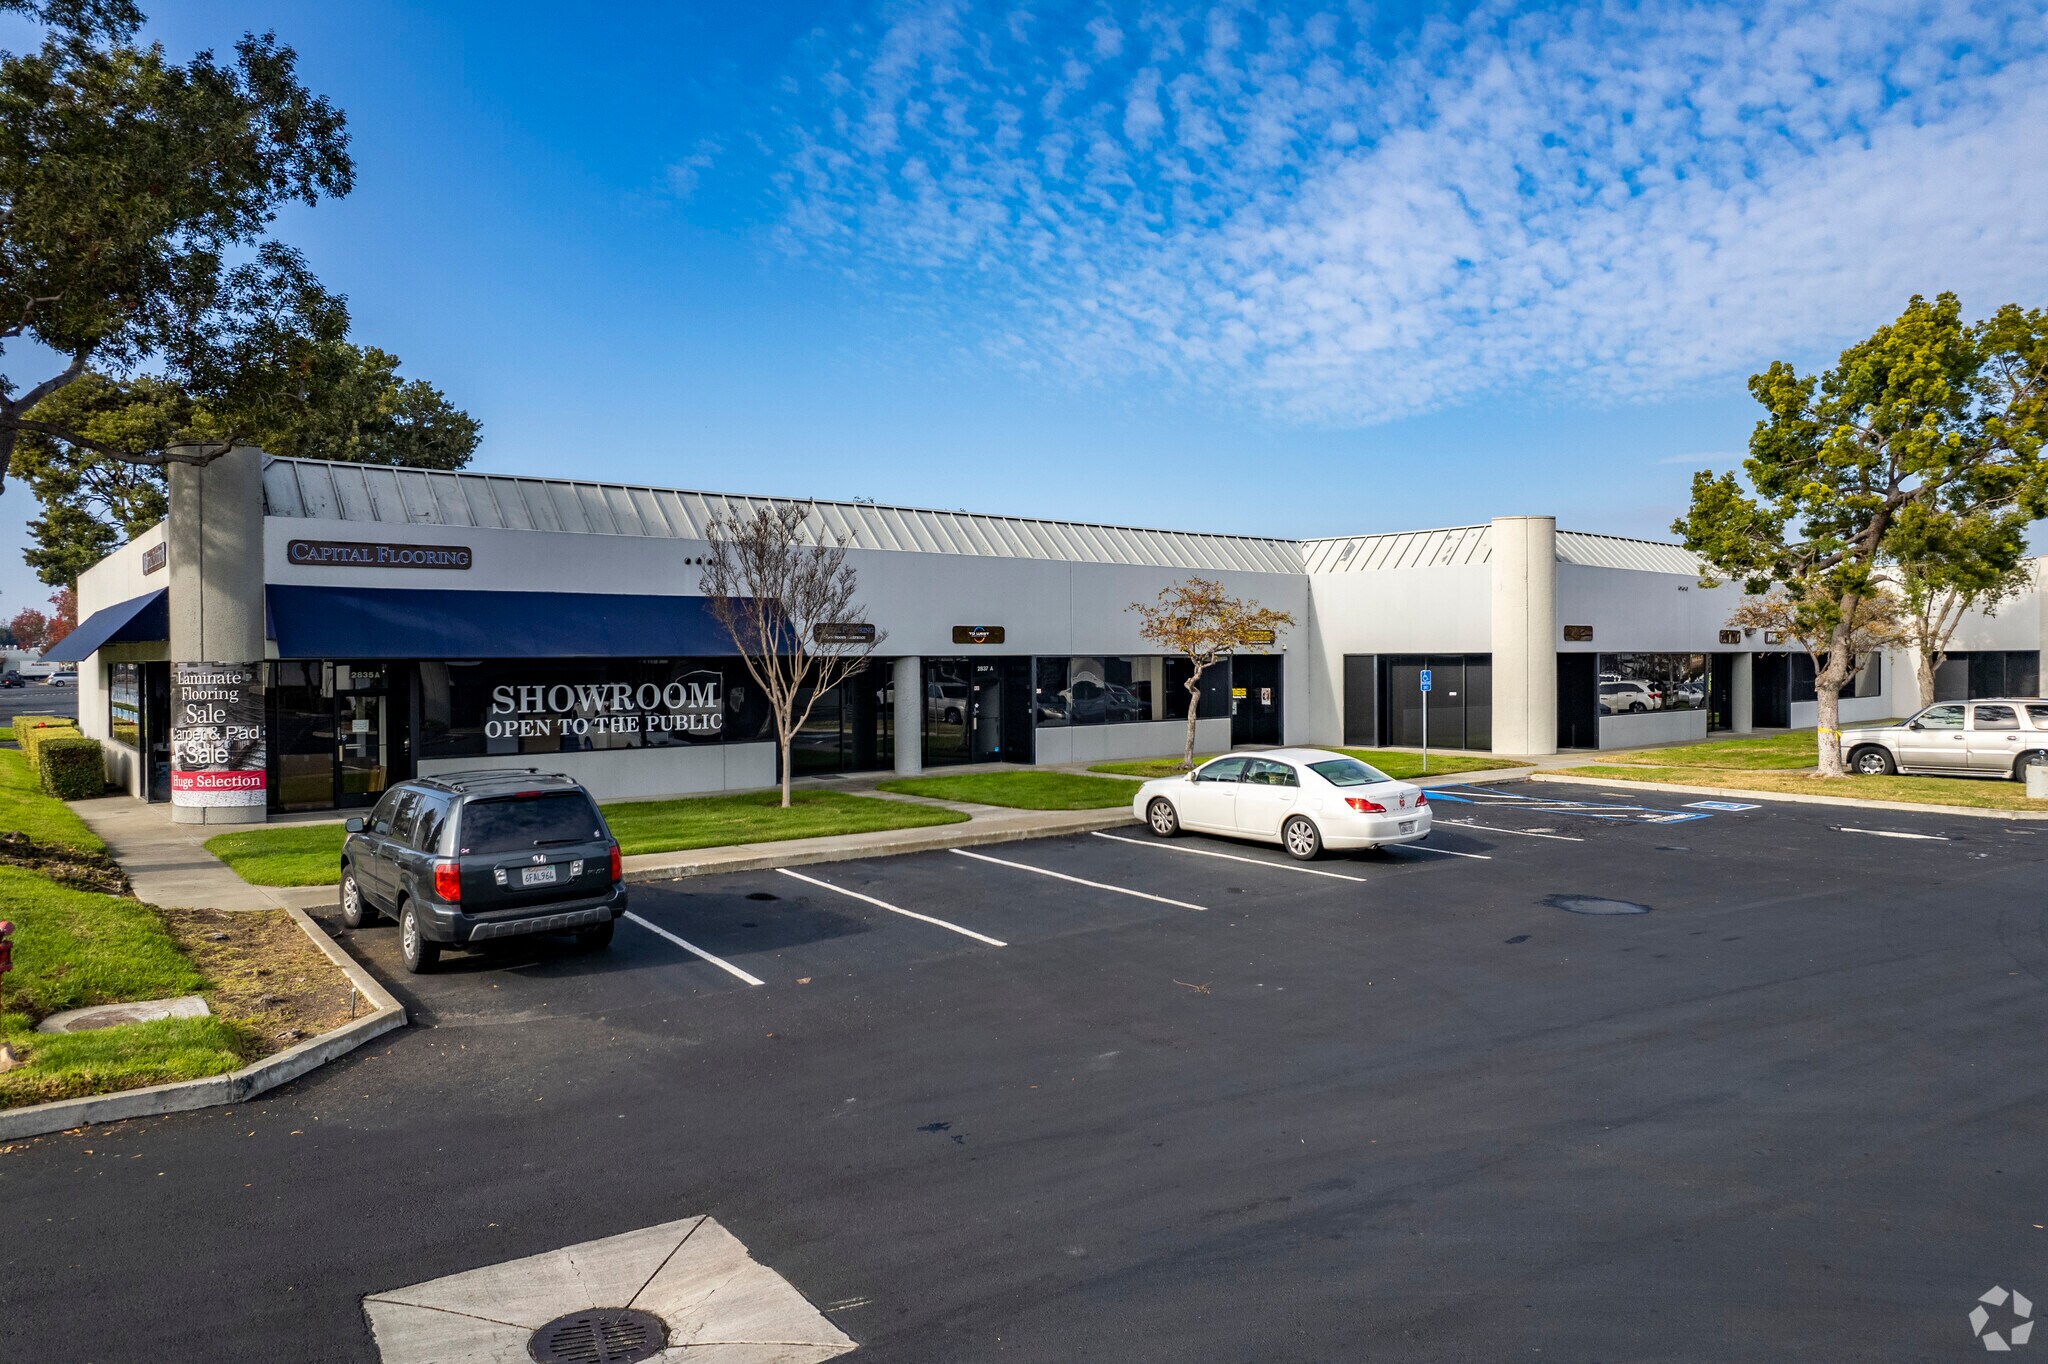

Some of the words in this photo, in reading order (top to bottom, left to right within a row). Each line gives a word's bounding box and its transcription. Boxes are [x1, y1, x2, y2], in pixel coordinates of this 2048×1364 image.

[177, 671, 241, 685] Laminate
[182, 686, 239, 703] Flooring
[492, 682, 718, 715] SHOWROOM
[186, 703, 226, 724] Sale
[171, 727, 206, 741] Carpet
[209, 726, 221, 740] &
[226, 725, 260, 740] Pad
[484, 718, 552, 739] OPEN
[557, 717, 589, 735] TO
[594, 716, 640, 735] THE
[645, 713, 723, 732] PUBLIC
[186, 744, 229, 764] Sale
[173, 774, 194, 789] Huge
[196, 775, 261, 787] Selection
[525, 872, 554, 882] 6FAL964
